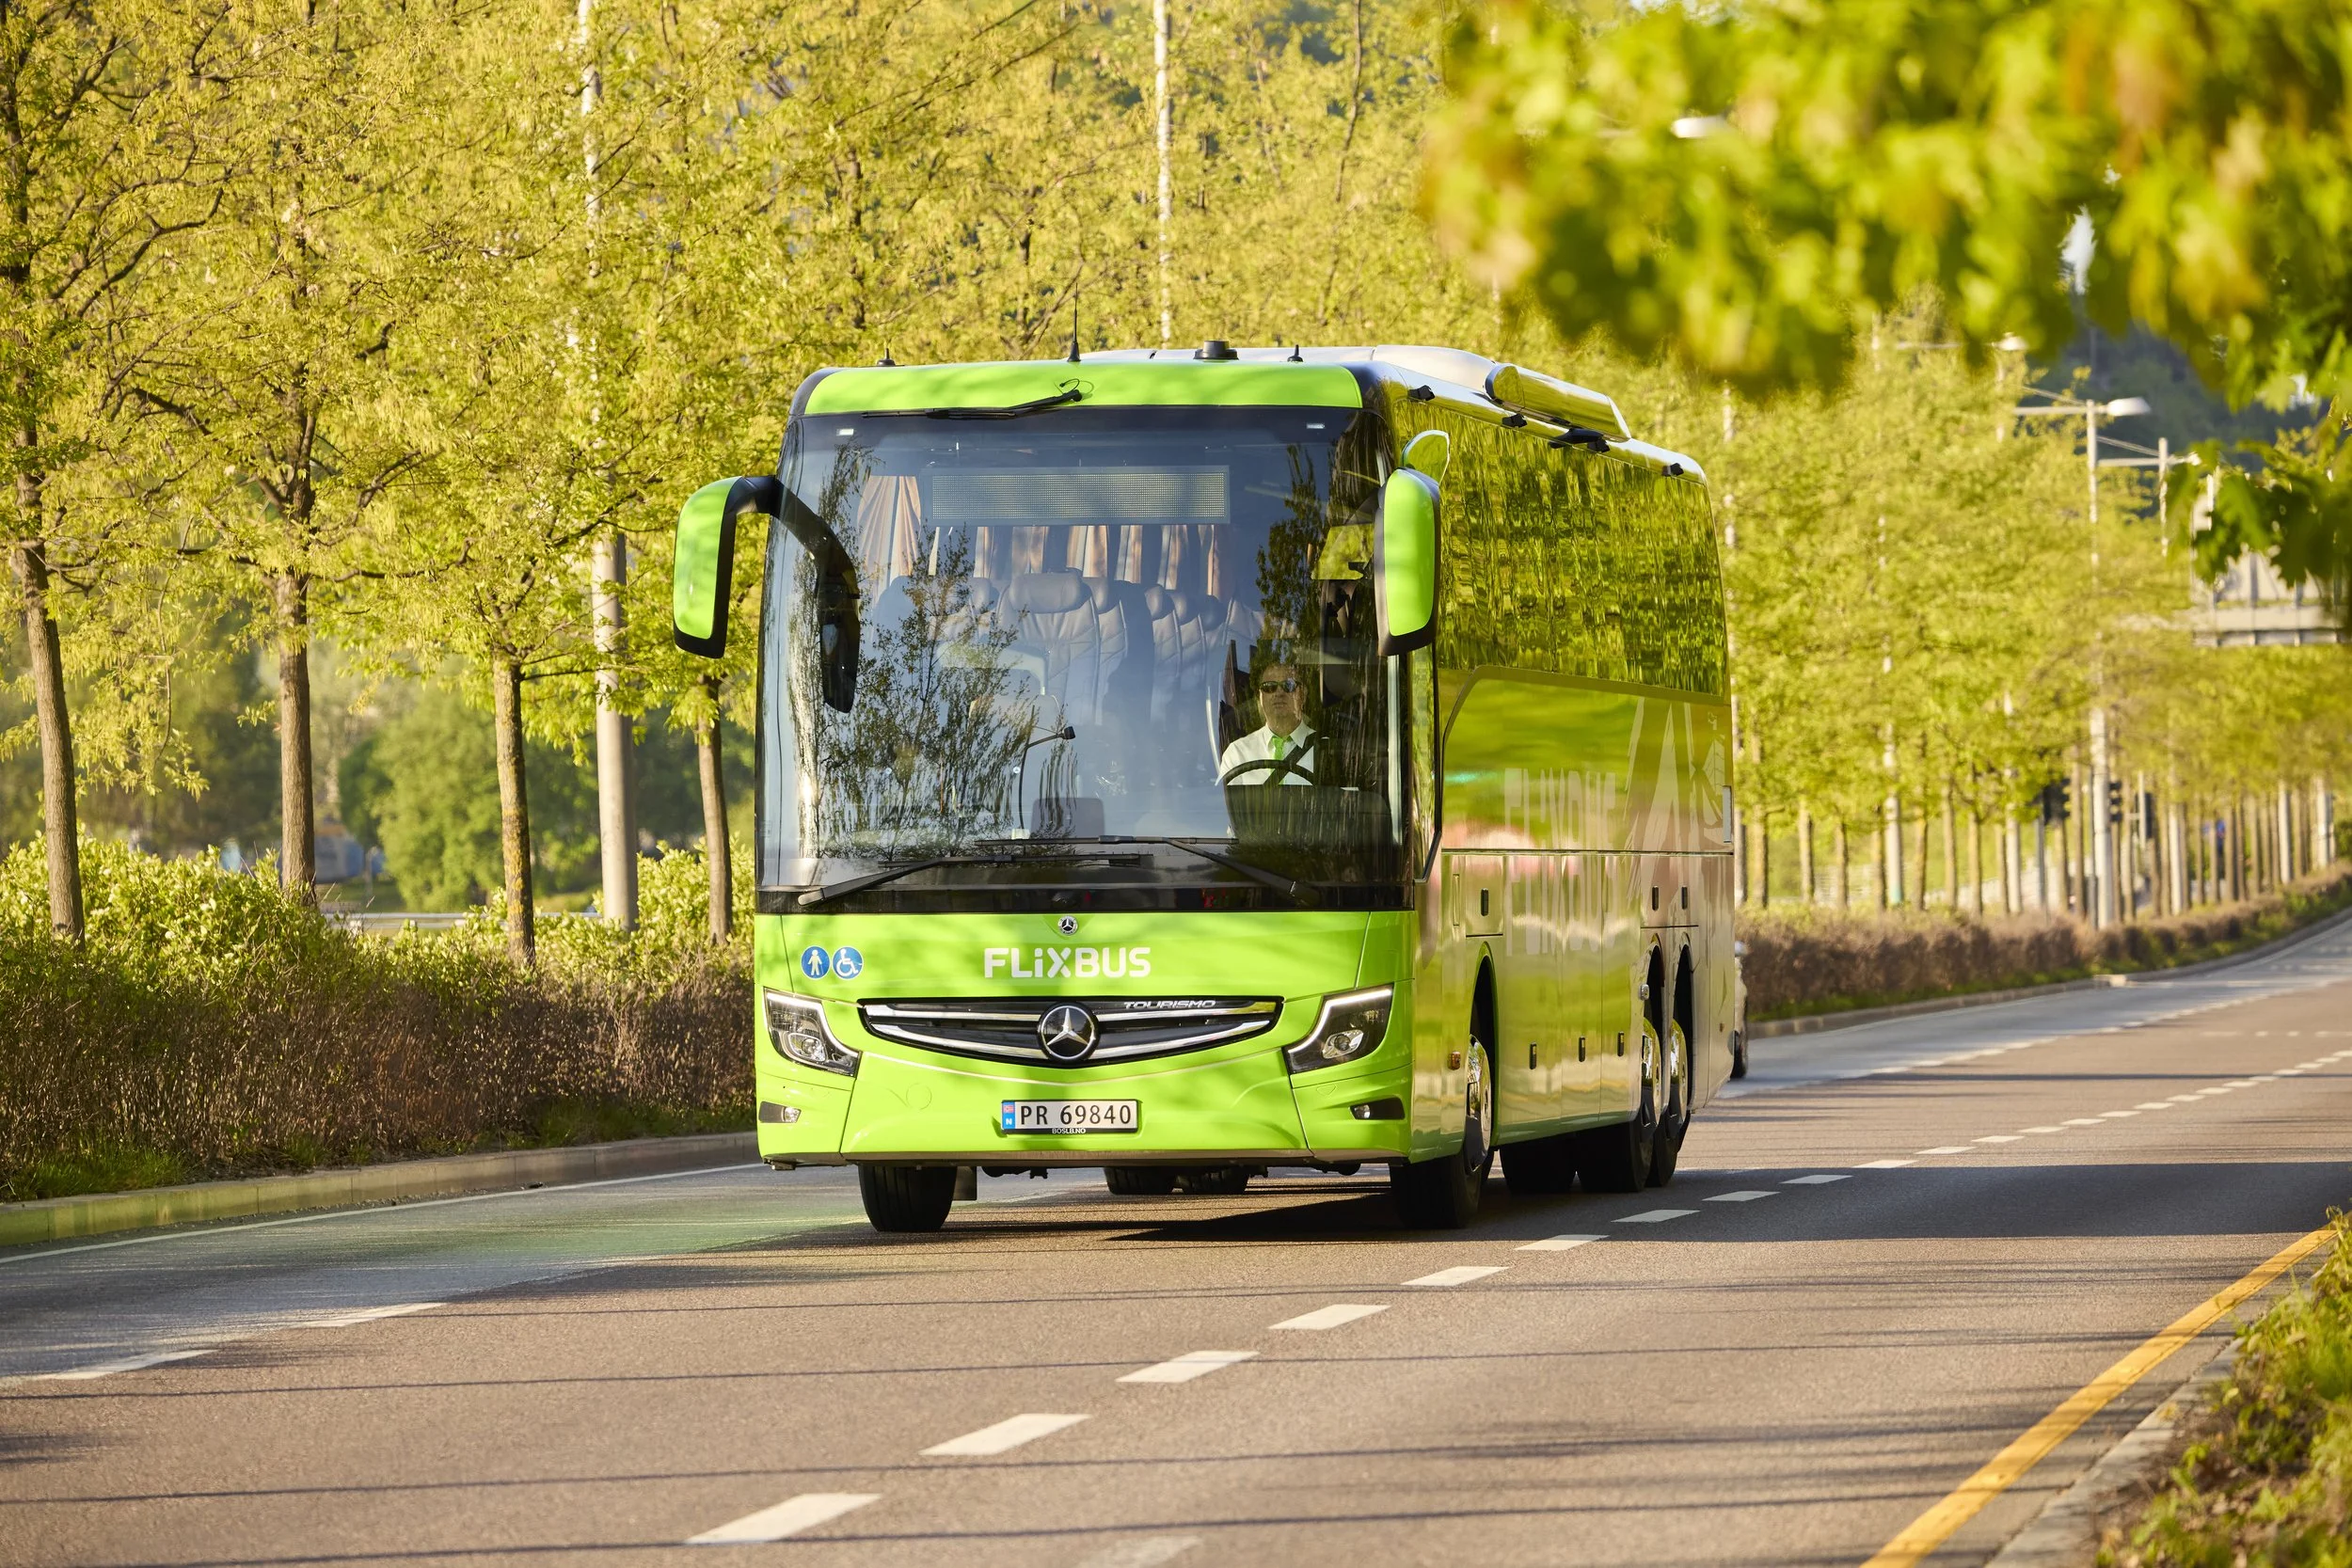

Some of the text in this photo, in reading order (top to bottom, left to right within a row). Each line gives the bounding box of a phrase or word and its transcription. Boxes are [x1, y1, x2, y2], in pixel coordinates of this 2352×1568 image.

[1124, 1000, 1216, 1009] TOURISMO
[1020, 1104, 1132, 1125] PR 69840
